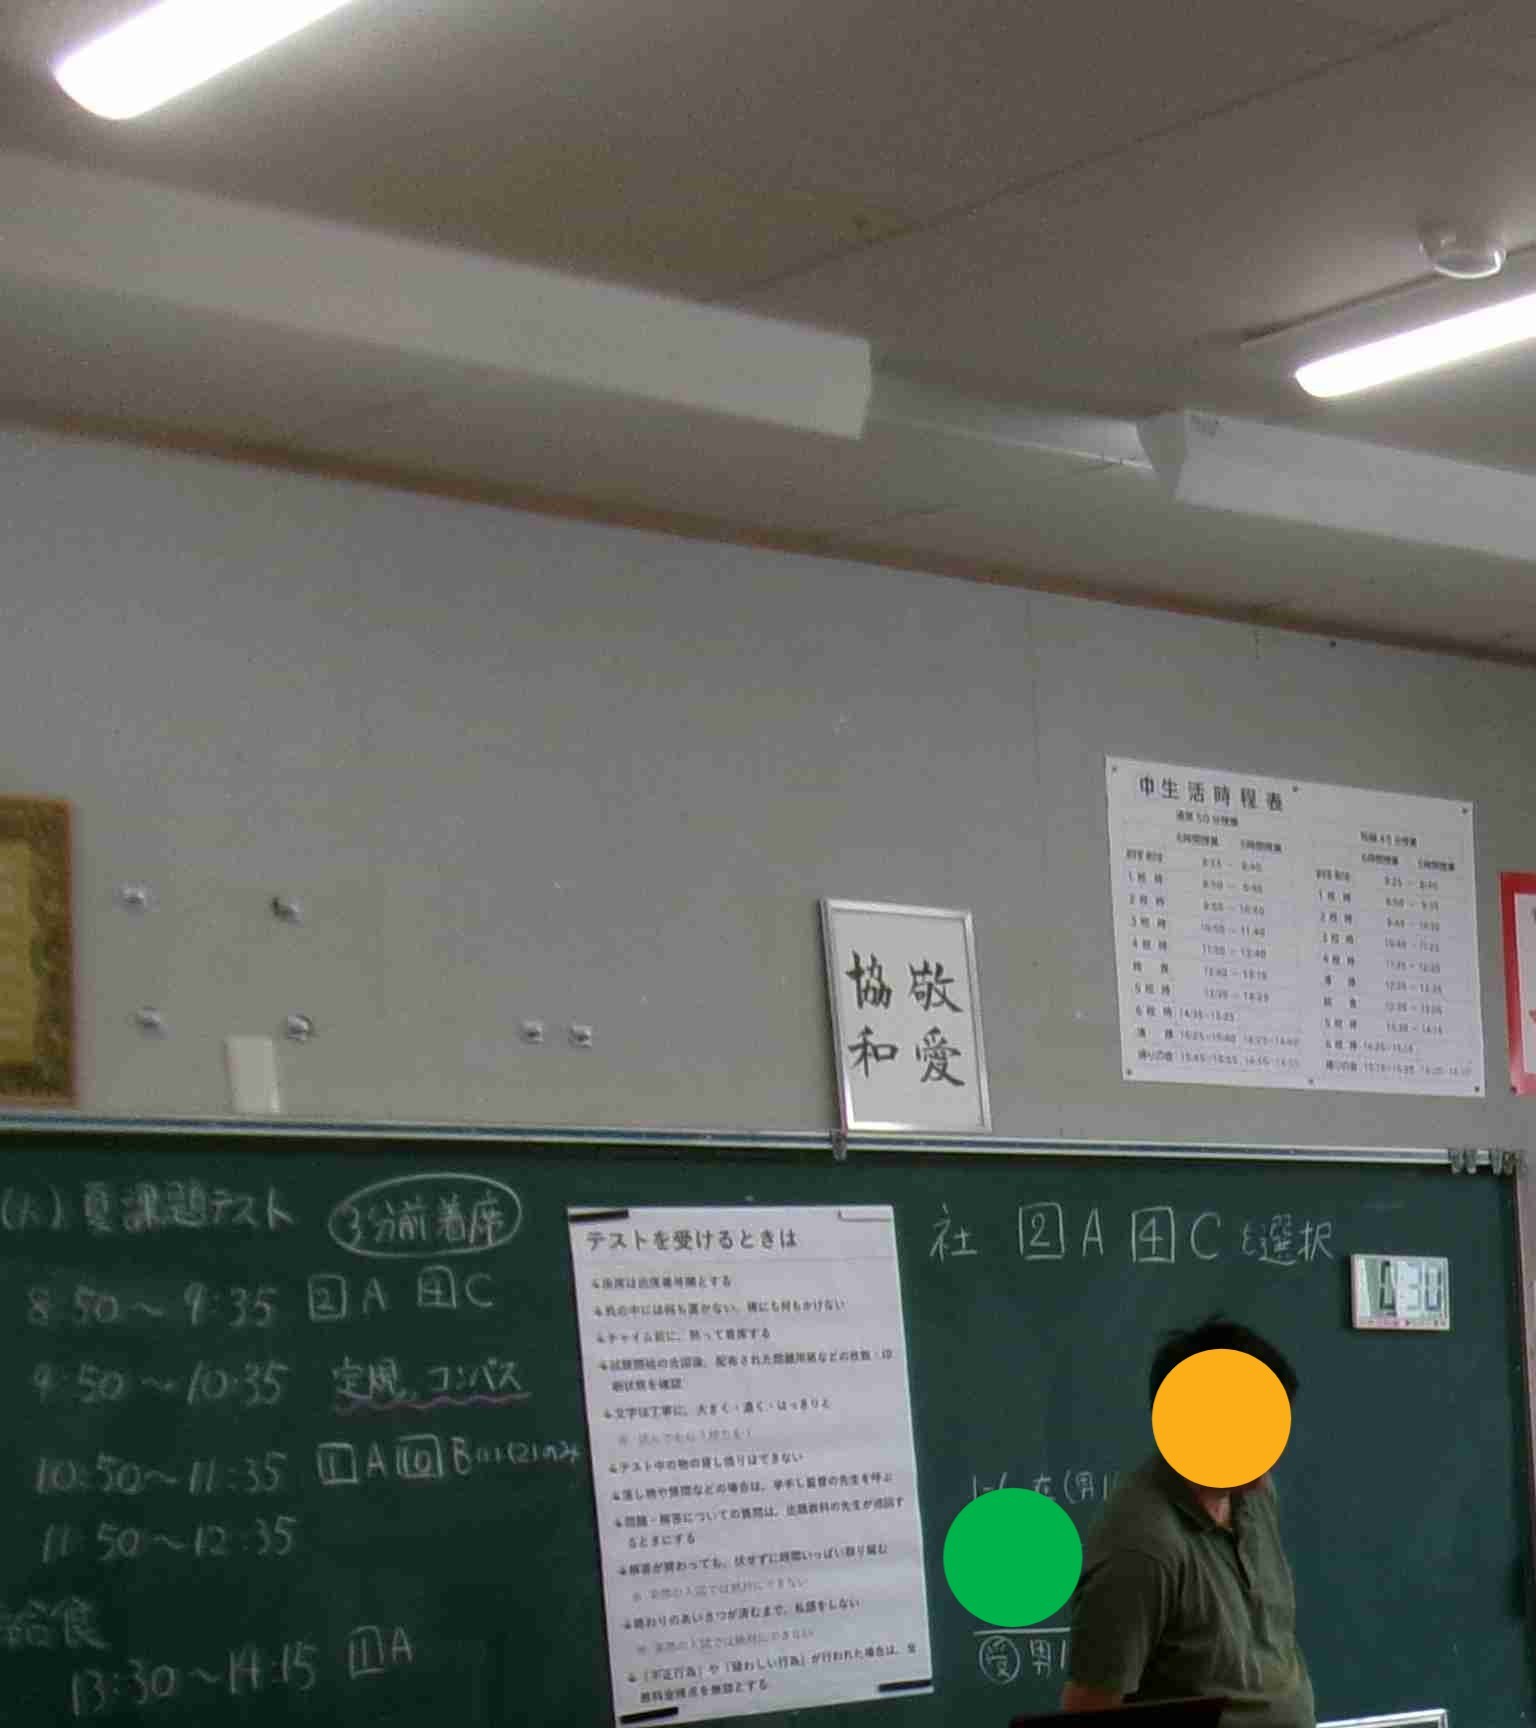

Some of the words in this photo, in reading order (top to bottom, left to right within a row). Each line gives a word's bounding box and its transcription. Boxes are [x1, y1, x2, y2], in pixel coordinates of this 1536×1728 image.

[585, 1229, 800, 1252] テストを受けるときは
[929, 1202, 978, 1262] 社
